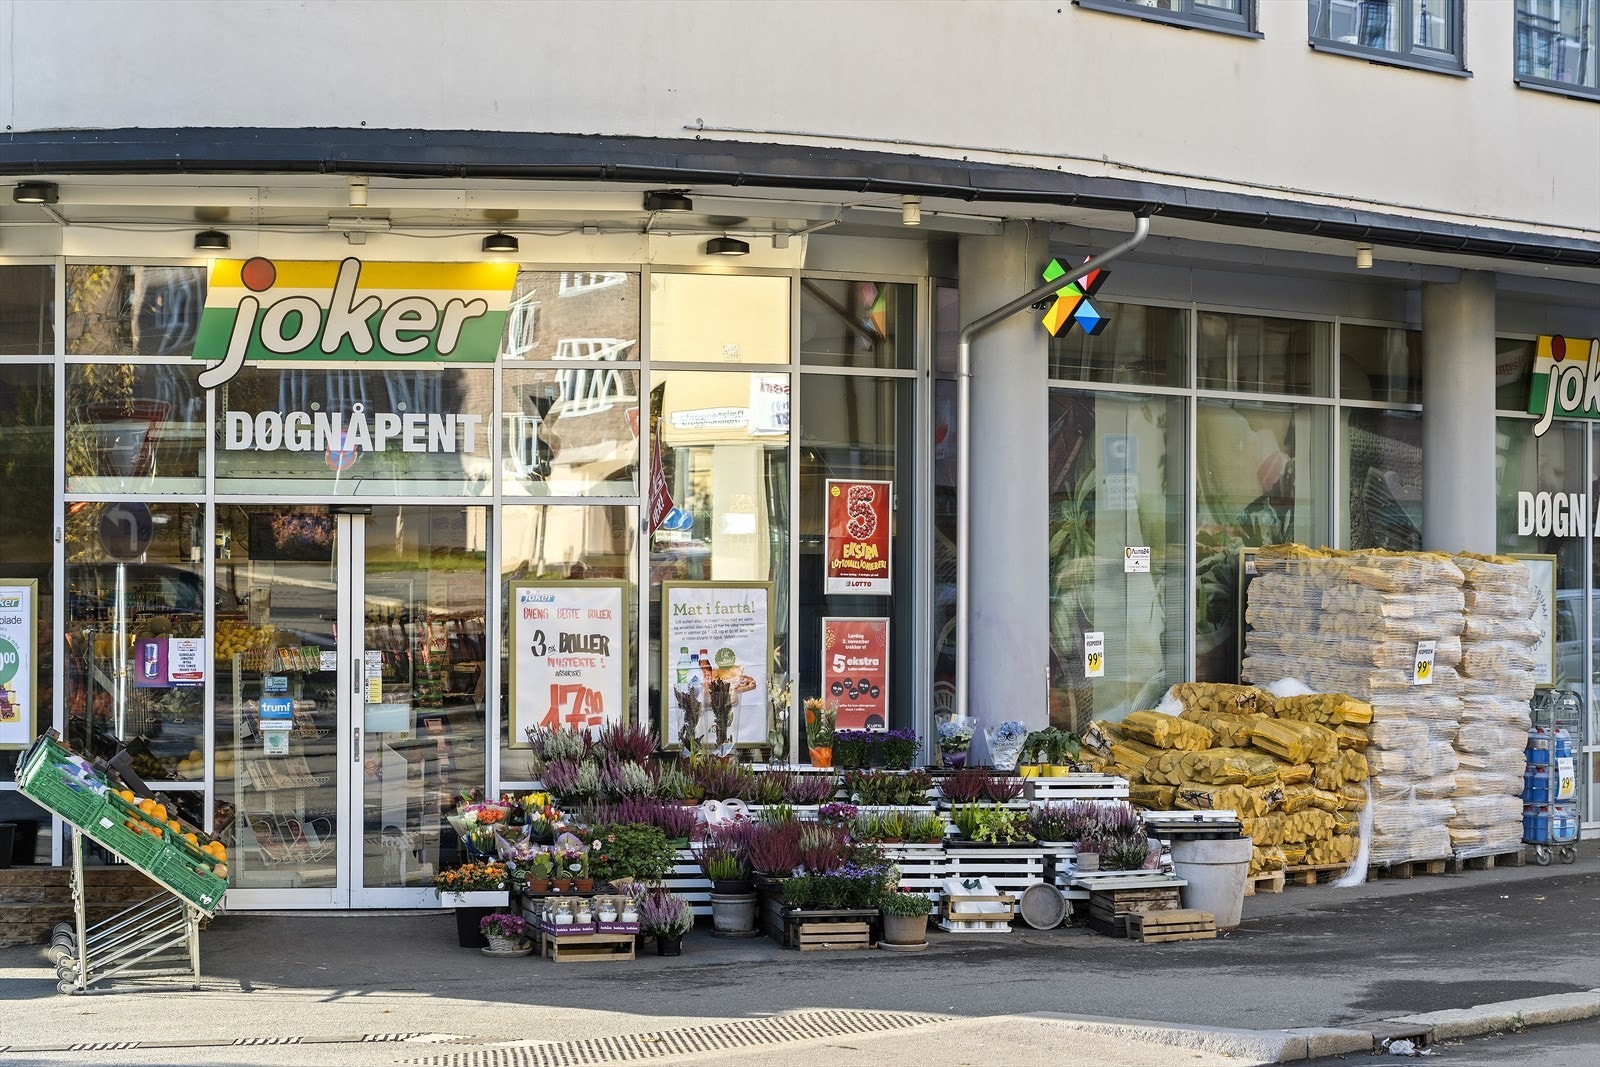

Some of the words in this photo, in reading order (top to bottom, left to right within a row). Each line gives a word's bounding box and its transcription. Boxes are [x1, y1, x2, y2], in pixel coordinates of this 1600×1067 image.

[198, 256, 488, 390] joker
[225, 402, 482, 453] DØGNÅPENT
[847, 485, 877, 540] 5
[1518, 490, 1600, 538] DØGN
[843, 542, 879, 560] EKSTRA
[521, 590, 554, 605] joker
[523, 607, 549, 620] BYENS
[557, 607, 580, 620] BESTE
[673, 603, 702, 616] Mat
[706, 602, 711, 615] i
[715, 600, 755, 615] farta!
[530, 629, 547, 657] 3
[559, 632, 610, 657] BOLLER
[547, 658, 596, 668] NYSTEKTE
[832, 654, 846, 674] 5
[847, 657, 880, 666] ekstra
[1088, 653, 1098, 666] 99
[1418, 661, 1428, 673] 99
[262, 703, 290, 712] trumf
[1562, 777, 1570, 788] 29
